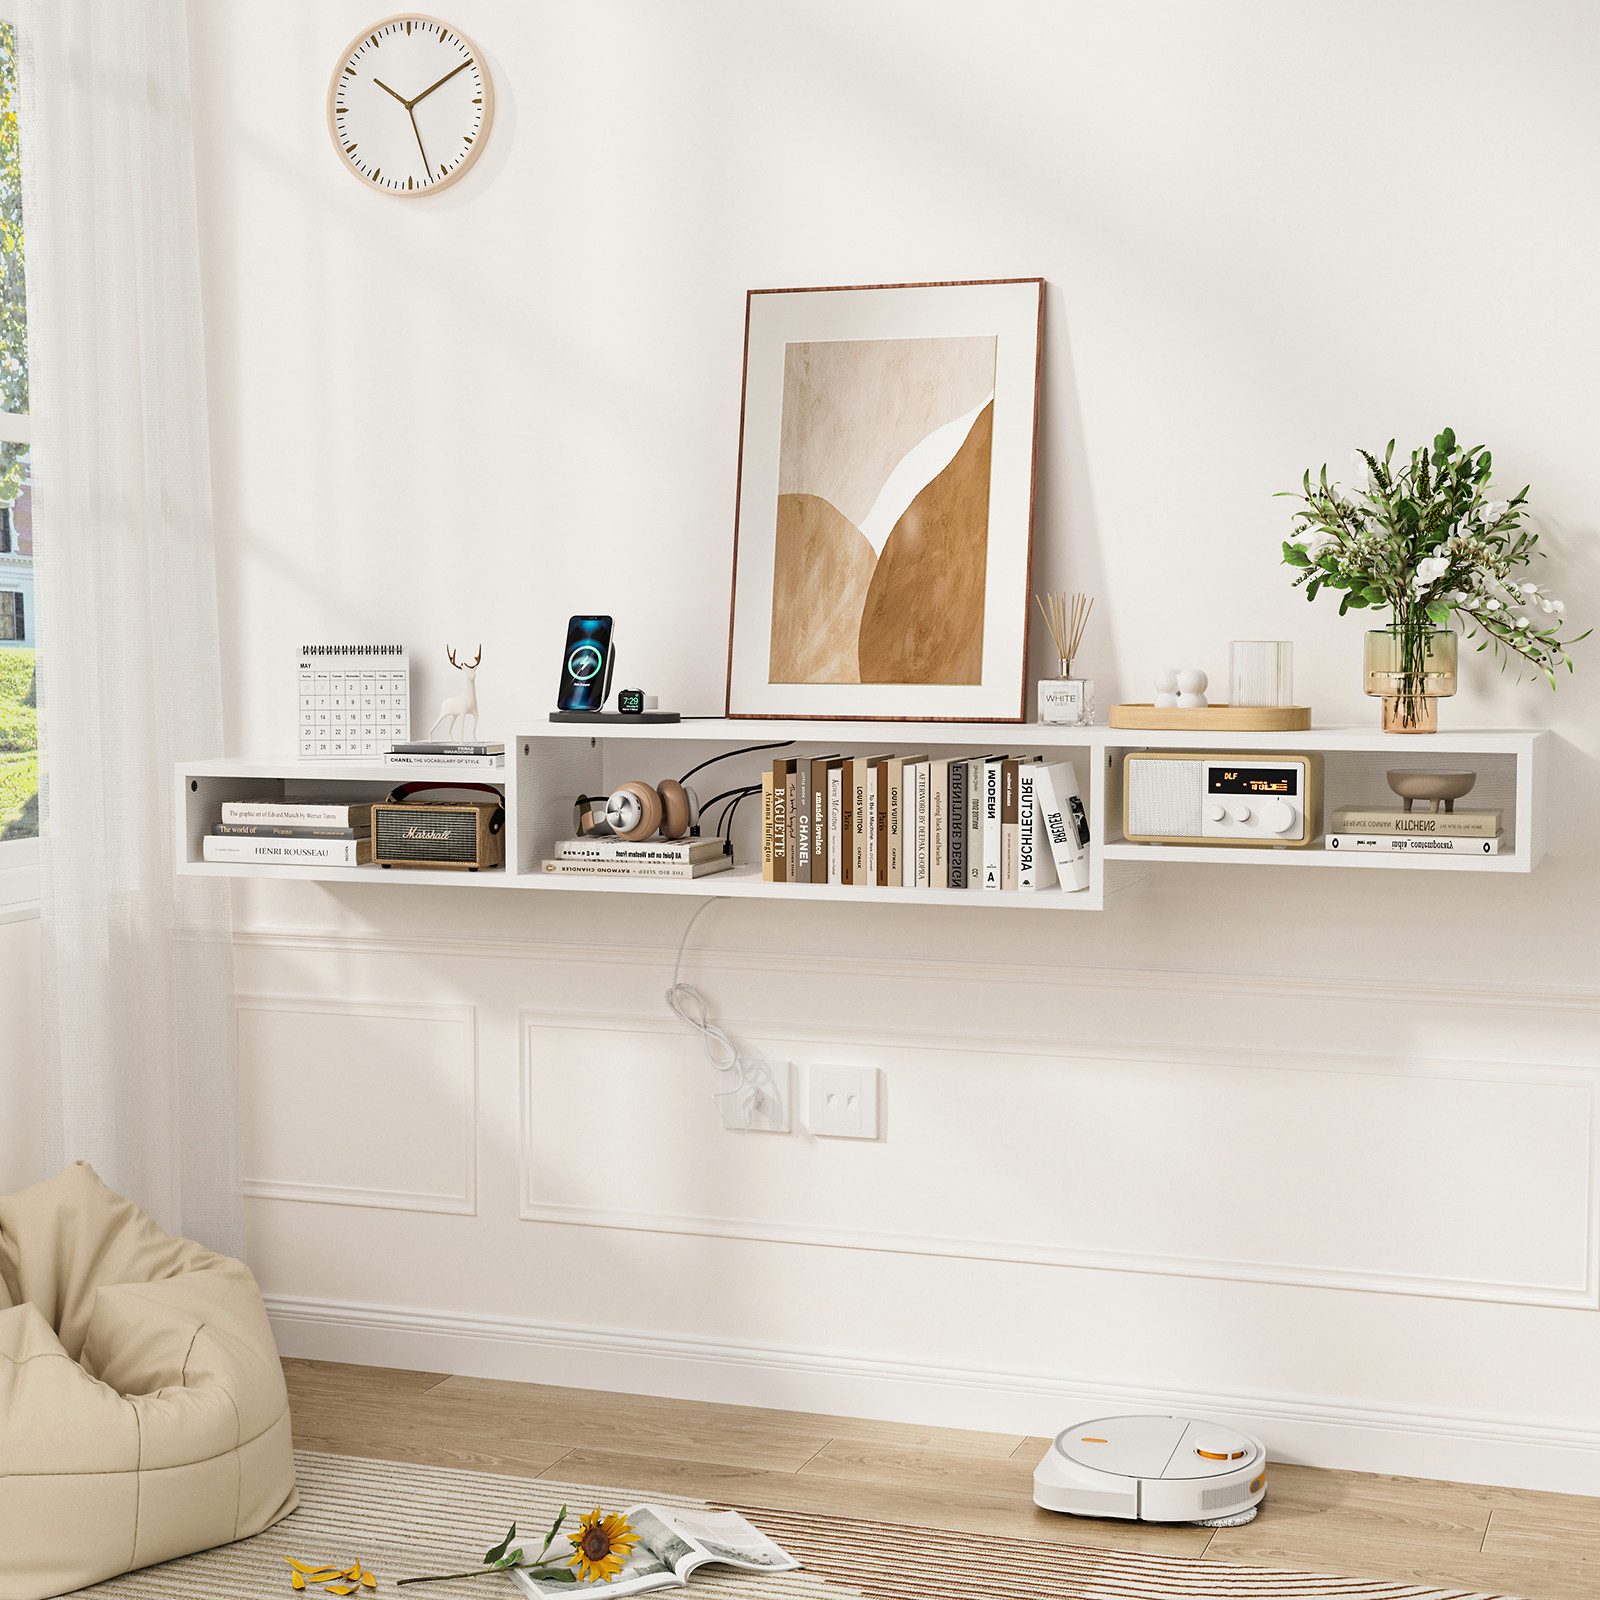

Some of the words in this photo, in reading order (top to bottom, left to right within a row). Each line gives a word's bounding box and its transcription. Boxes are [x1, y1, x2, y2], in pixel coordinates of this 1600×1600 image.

[623, 696, 639, 705] 7:29
[1046, 694, 1076, 702] WHITE
[869, 802, 874, 810] Be
[934, 792, 942, 817] exploring
[774, 788, 785, 858] BAGUETTE
[918, 816, 925, 824] BY
[402, 826, 452, 840] Marshall
[764, 823, 773, 862] Huffington
[799, 815, 808, 867] CHANEL
[255, 847, 282, 855] HENRI
[284, 848, 329, 857] ROUSSEAU
